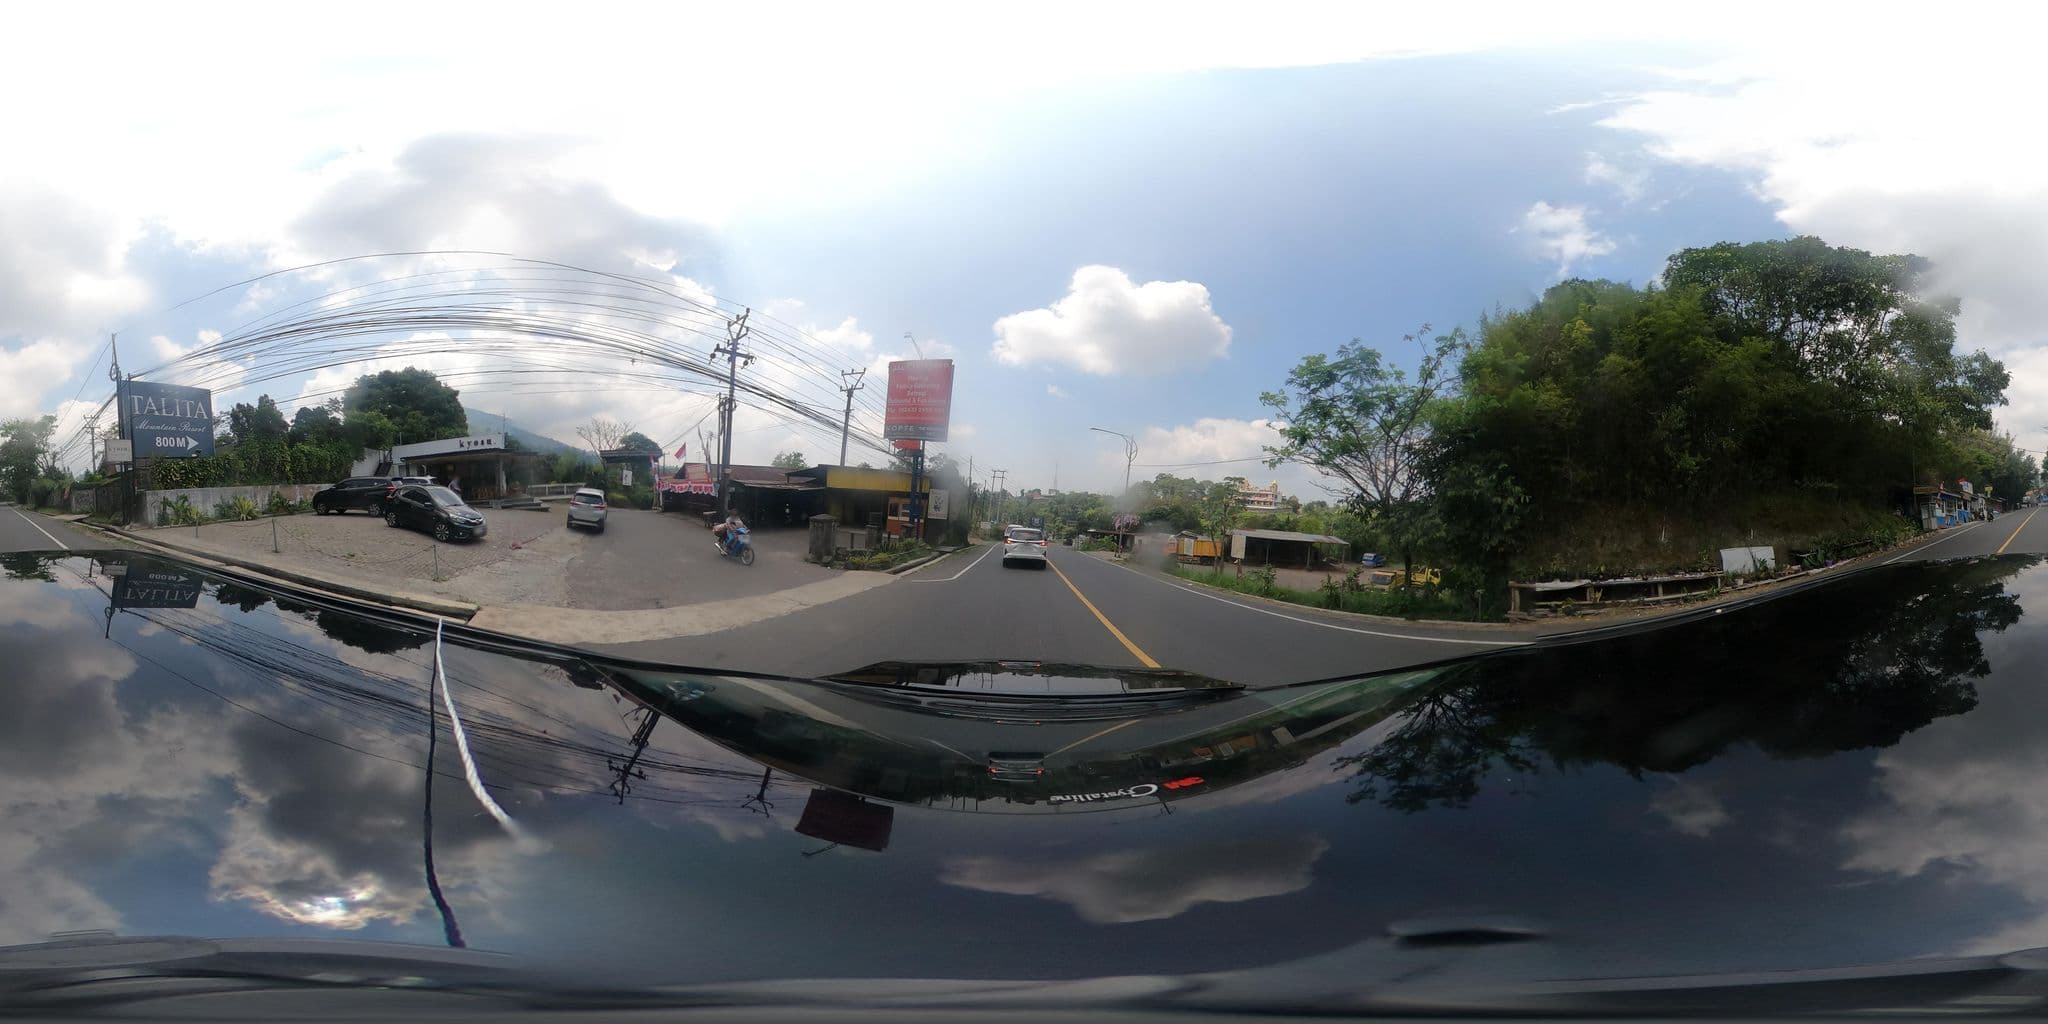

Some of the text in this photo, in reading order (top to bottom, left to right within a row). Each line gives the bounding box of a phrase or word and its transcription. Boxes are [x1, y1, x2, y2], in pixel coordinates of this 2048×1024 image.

[128, 395, 209, 419] TALITA
[136, 417, 207, 432] Mountain Resort
[1050, 783, 1158, 803] Crystalline
